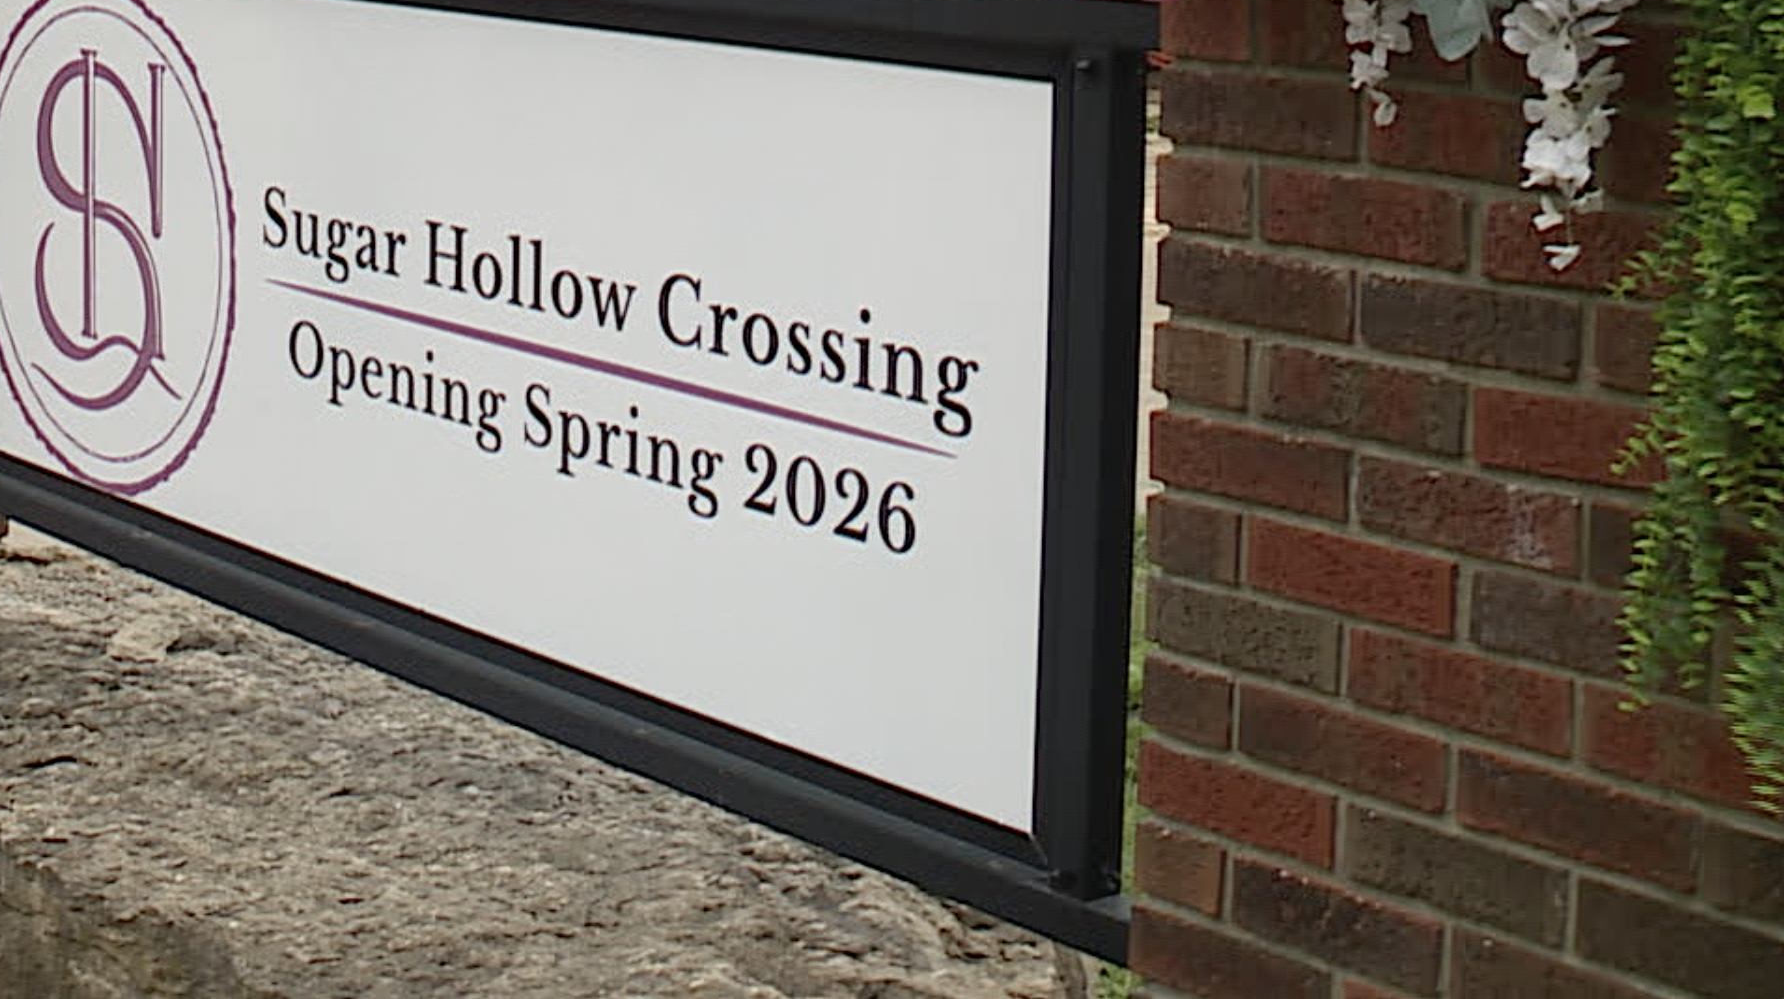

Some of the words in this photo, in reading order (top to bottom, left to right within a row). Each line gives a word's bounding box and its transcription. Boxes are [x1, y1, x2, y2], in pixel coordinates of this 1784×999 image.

[263, 186, 407, 284] Sugar
[423, 219, 637, 332] Hollow
[658, 273, 979, 438] Crossing
[289, 320, 506, 454] Opening
[523, 383, 723, 519] Spring
[743, 443, 917, 554] 2026
